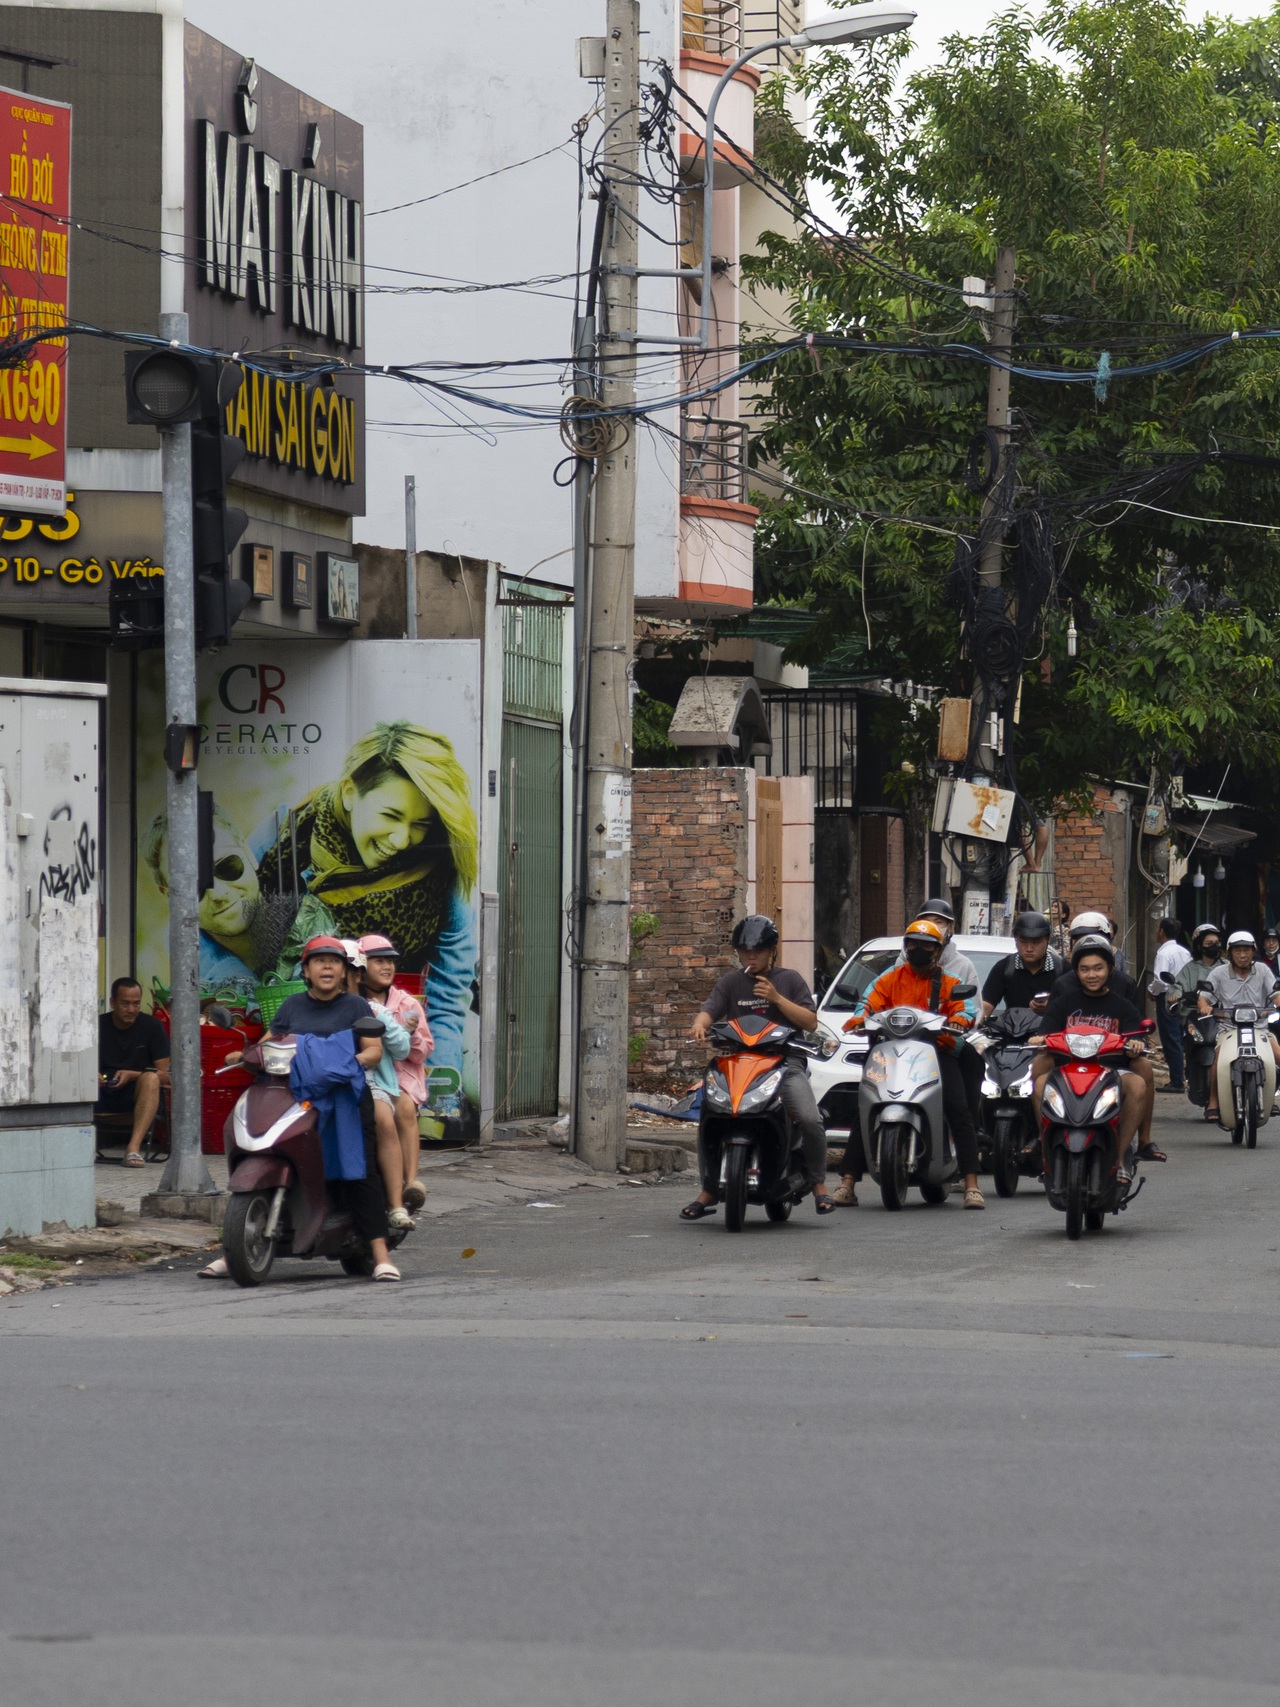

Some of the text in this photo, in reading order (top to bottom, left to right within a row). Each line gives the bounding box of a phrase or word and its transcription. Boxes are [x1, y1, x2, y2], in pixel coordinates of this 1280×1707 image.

[10, 129, 29, 200] HỒ
[200, 57, 280, 316] MẮT
[310, 373, 356, 485] GÒN
[14, 557, 40, 582] 10
[59, 557, 104, 584] Gò
[204, 746, 310, 755] EYEGLASSES
